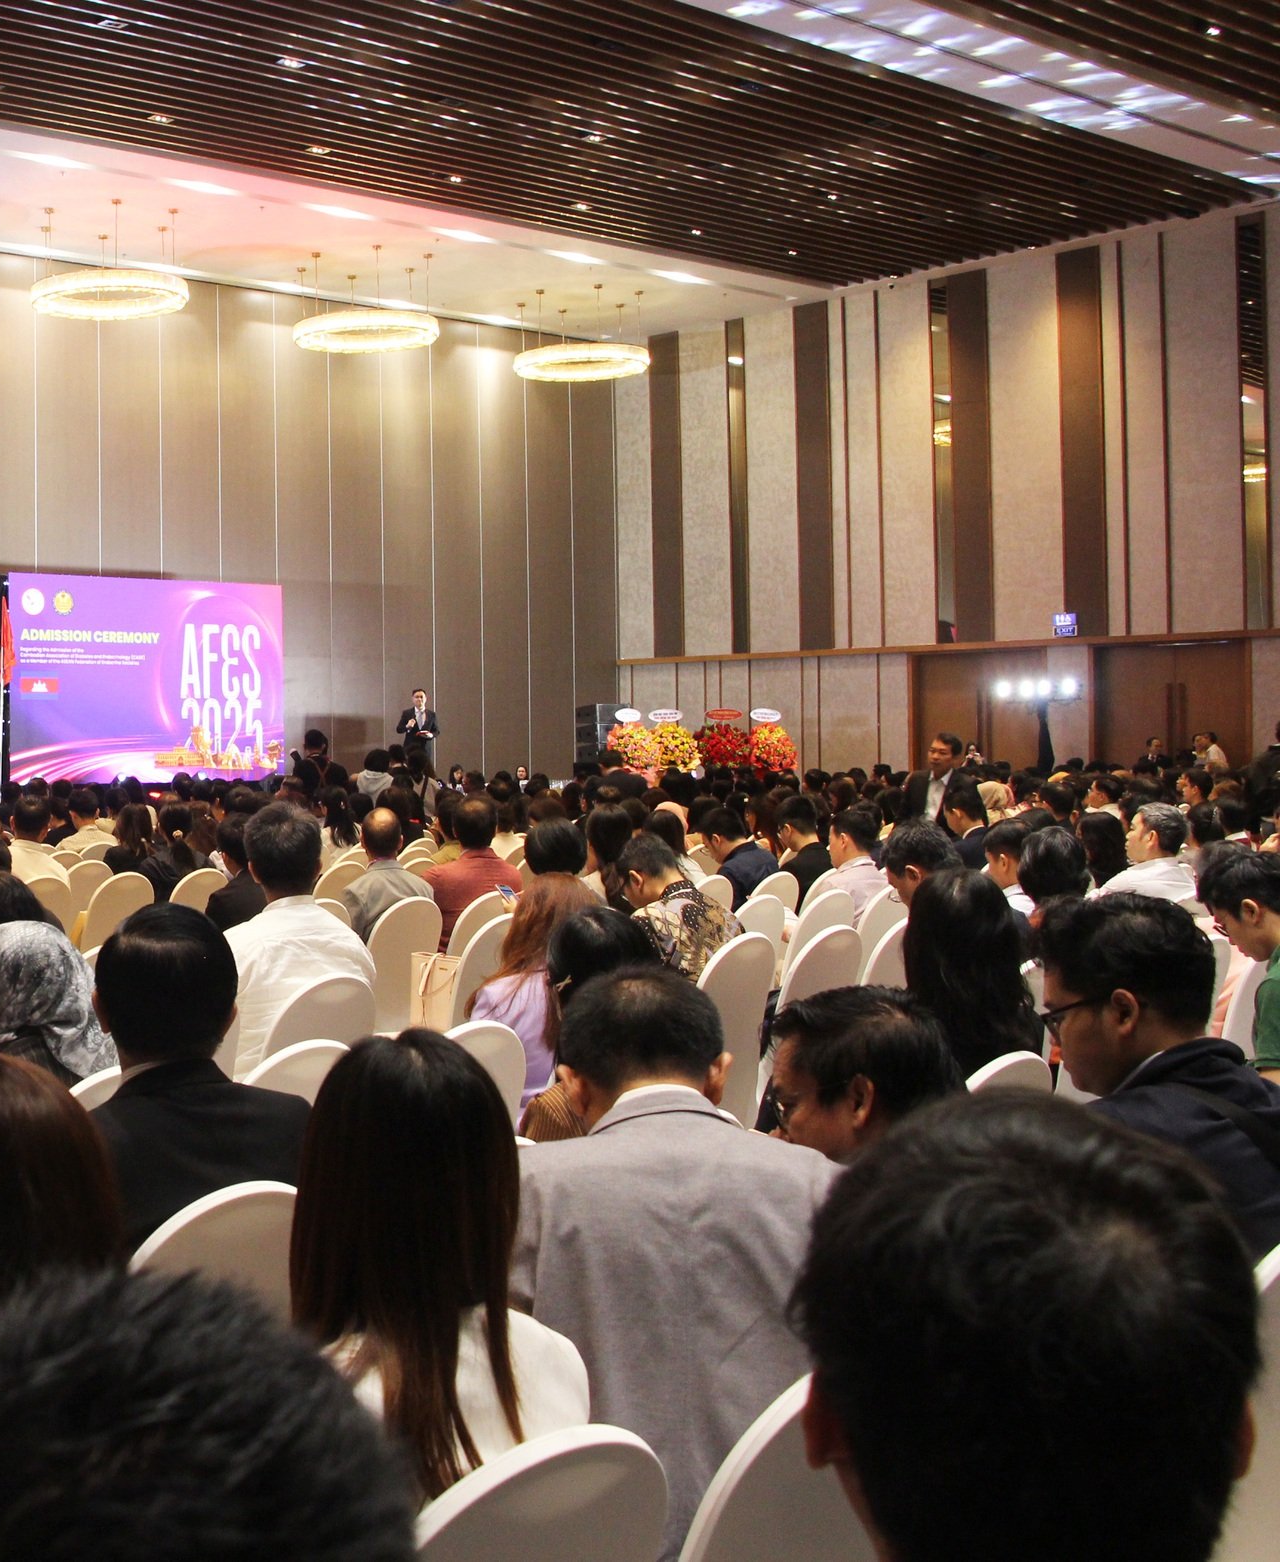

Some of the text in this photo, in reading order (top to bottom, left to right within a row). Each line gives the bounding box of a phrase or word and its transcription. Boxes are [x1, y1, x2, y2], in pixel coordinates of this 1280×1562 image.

[21, 628, 160, 644] ADMISSION CEREMONY
[180, 623, 261, 700] AFES
[181, 698, 264, 756] 2025
